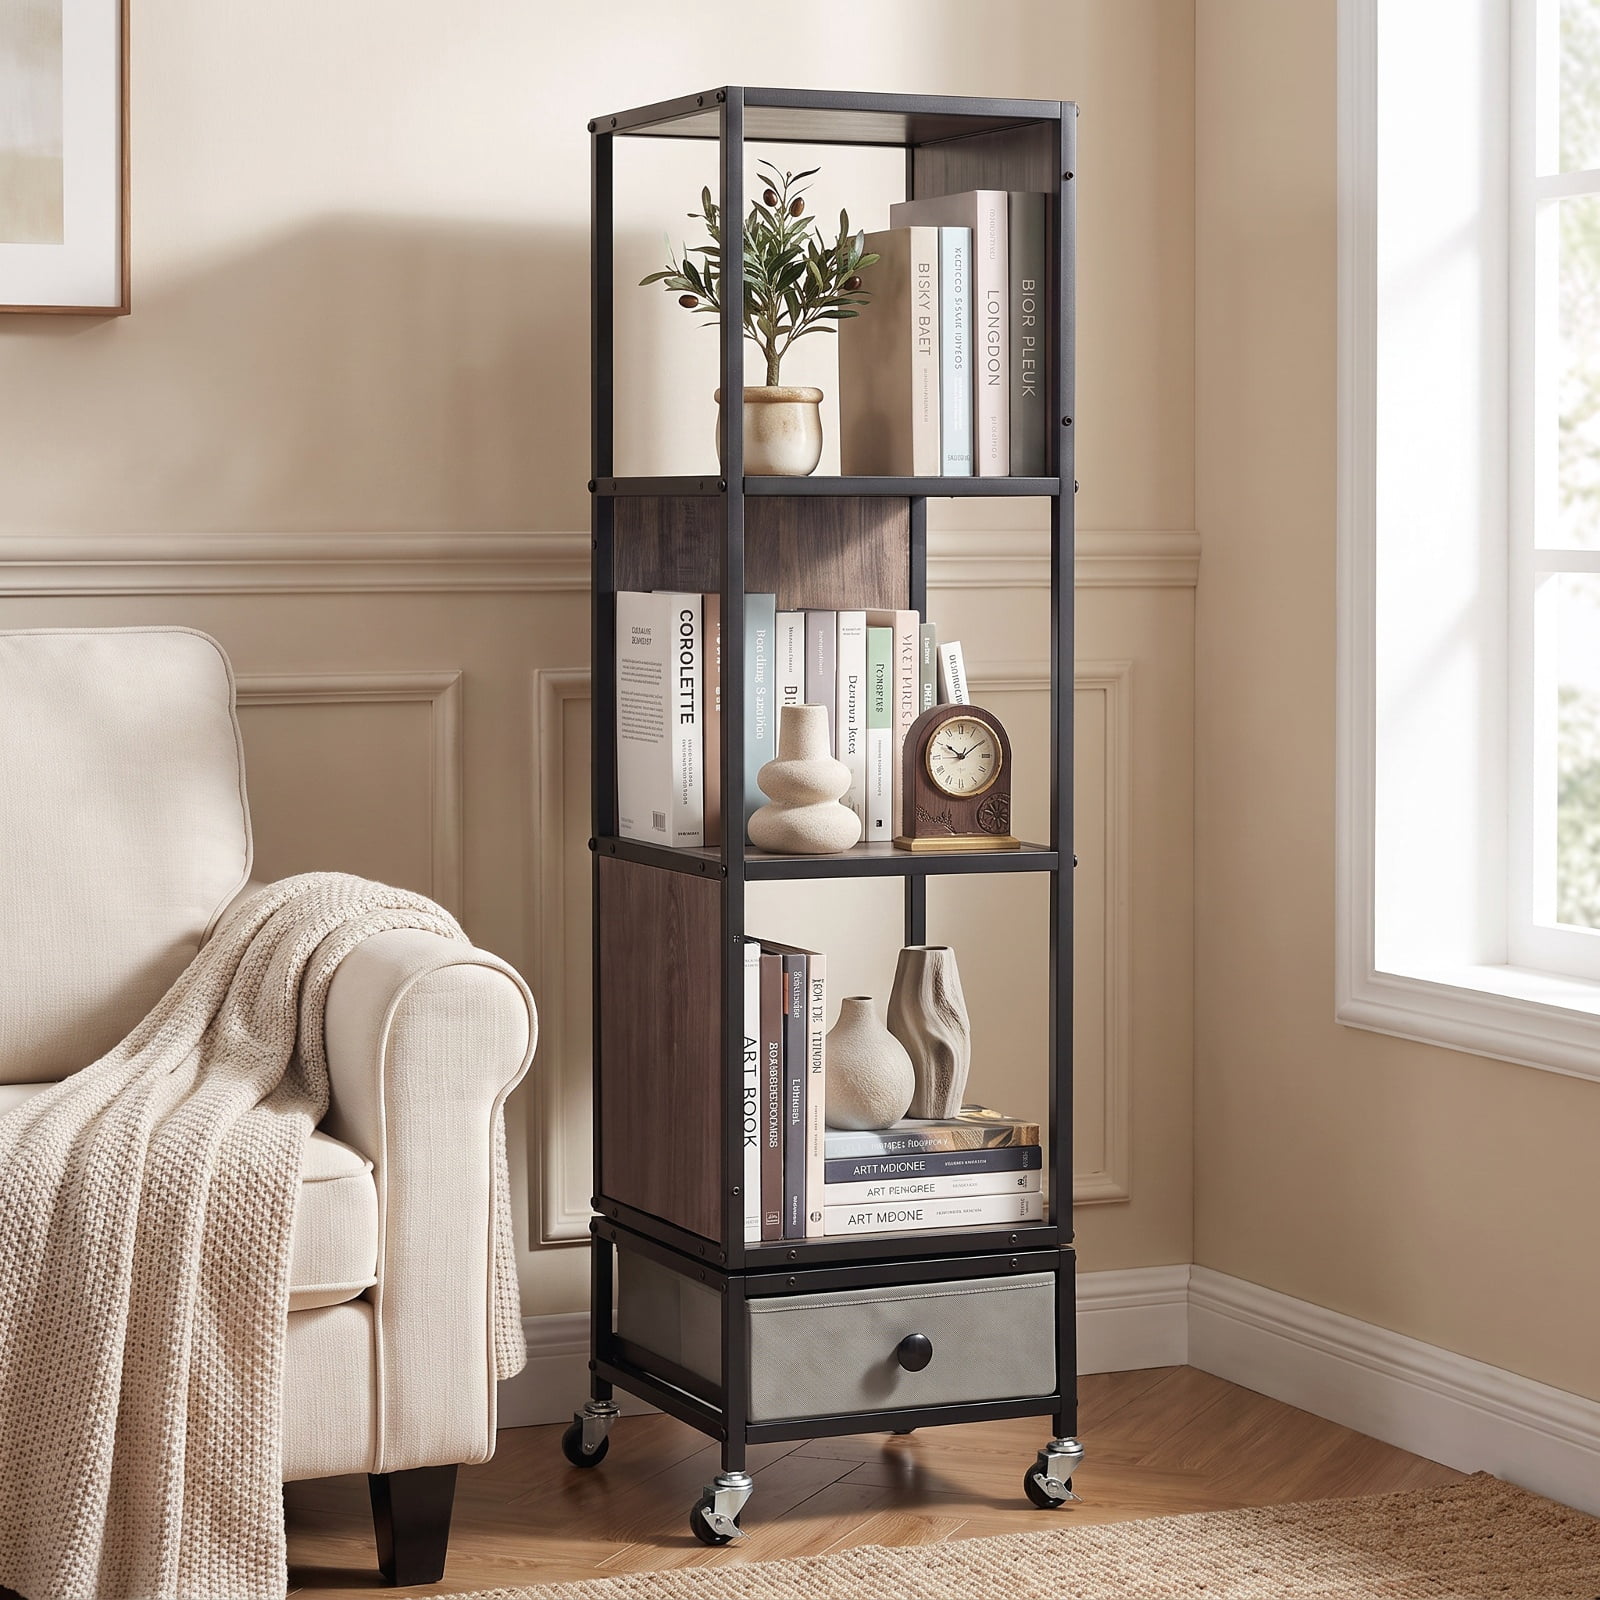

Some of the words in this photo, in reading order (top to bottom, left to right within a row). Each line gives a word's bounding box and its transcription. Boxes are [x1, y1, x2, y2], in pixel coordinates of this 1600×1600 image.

[918, 263, 930, 310] BISKY
[1022, 279, 1036, 327] BIOR
[918, 316, 930, 355] BAET
[987, 290, 1001, 386] LONGDON
[1022, 336, 1036, 397] PLEUK
[680, 609, 694, 725] COROLETTE
[744, 1036, 757, 1077] ART
[744, 1087, 757, 1148] BOOK
[853, 1164, 879, 1176] ARTT
[866, 1186, 886, 1197] ART
[847, 1212, 873, 1226] ART
